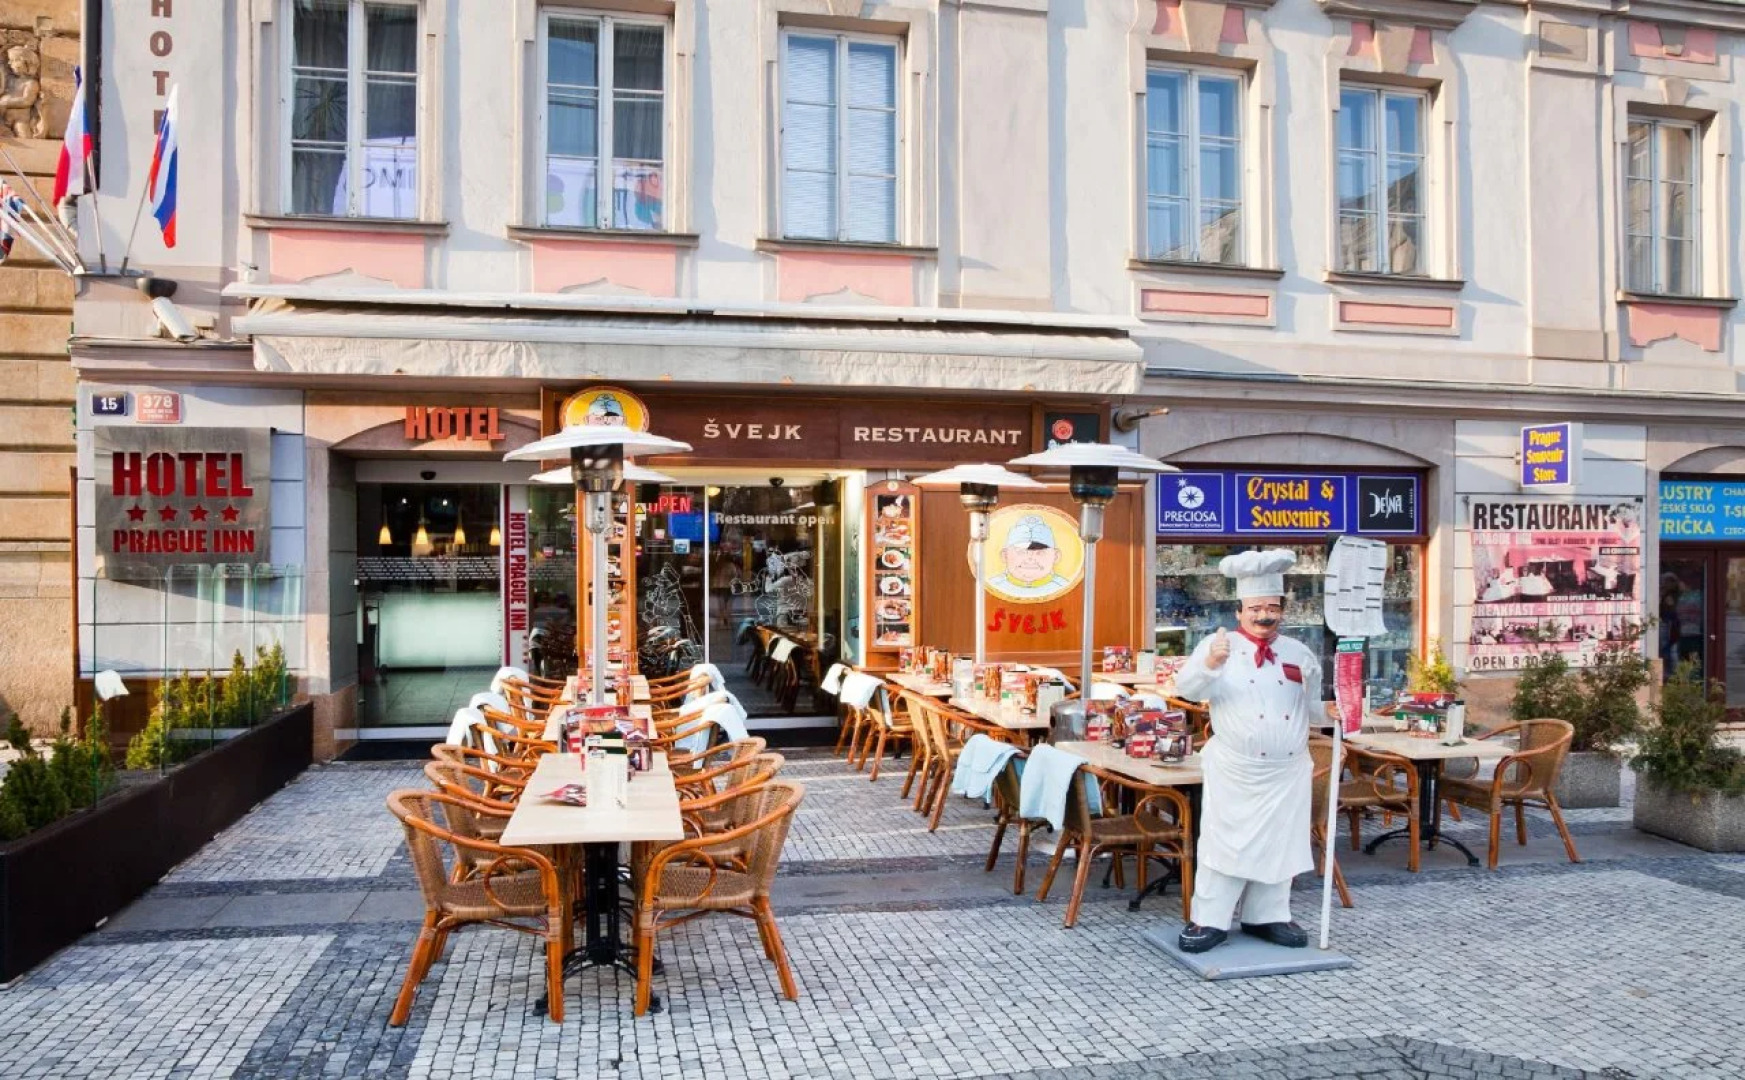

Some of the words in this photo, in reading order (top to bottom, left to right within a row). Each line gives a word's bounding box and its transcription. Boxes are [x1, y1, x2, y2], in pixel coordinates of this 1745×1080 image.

[101, 397, 118, 411] 15
[143, 395, 173, 409] 378
[404, 406, 506, 441] HOTEL
[703, 417, 803, 440] ŠVEJK
[854, 426, 1022, 445] RESTAURANT
[1530, 430, 1561, 447] Prague
[1526, 448, 1564, 464] Souvenir
[112, 452, 253, 497] HOTEL
[1533, 467, 1558, 482] Store
[1246, 476, 1309, 505] Crystal
[1320, 480, 1335, 501] &
[714, 512, 796, 525] Restaurant
[1164, 510, 1217, 522] PRECIOSA
[1251, 505, 1332, 528] Souvenirs
[1473, 503, 1612, 530] RESTAURANT
[113, 529, 207, 554] PRAGUE
[213, 529, 255, 554] INN
[510, 513, 527, 551] HOTEL
[510, 554, 527, 604] PRAGUE
[510, 609, 527, 630] INN
[1473, 656, 1506, 669] OPEN
